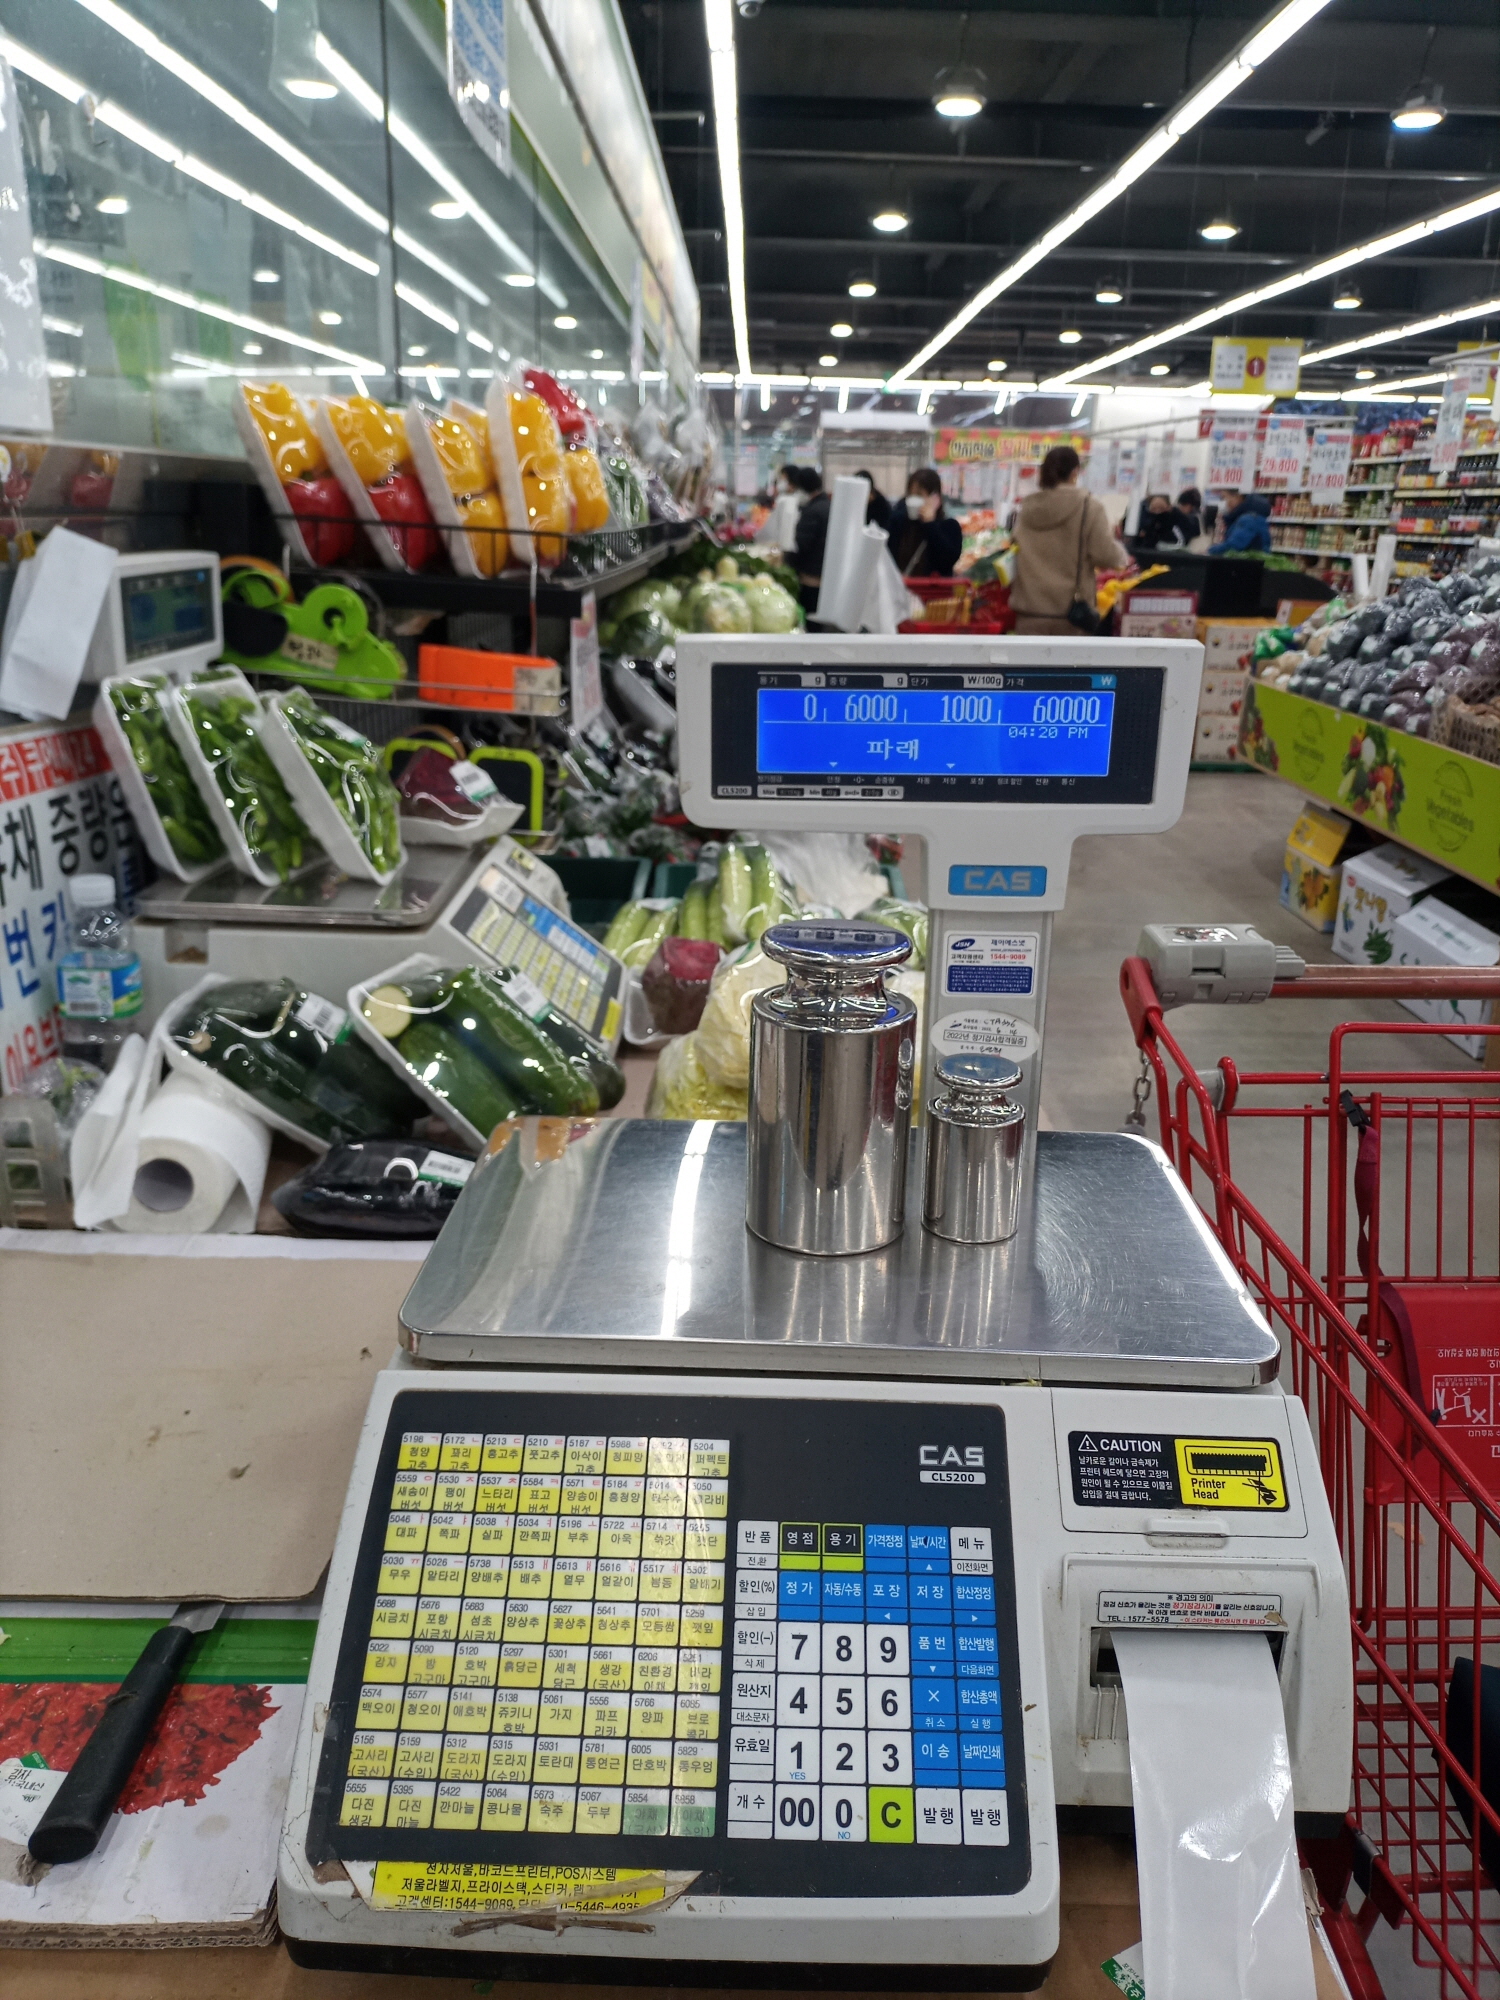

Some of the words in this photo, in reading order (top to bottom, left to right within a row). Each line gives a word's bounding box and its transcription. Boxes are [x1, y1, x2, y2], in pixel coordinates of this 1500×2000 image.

[804, 694, 817, 721] 0
[844, 694, 898, 722] 6000
[940, 695, 992, 722] 1000
[1032, 696, 1100, 724] 60000
[1008, 727, 1058, 738] 04:20
[1068, 727, 1088, 738] PM
[964, 870, 1032, 891] CAS
[403, 1435, 424, 1443] 5198
[445, 1436, 465, 1444] 5172
[486, 1437, 506, 1445] 5213
[1100, 1439, 1162, 1452] CAUTION
[528, 1450, 560, 1460] 풋고추
[919, 1444, 985, 1467] CAS
[1078, 1456, 1106, 1466] 날카로운
[1108, 1456, 1130, 1466] 칼이나
[1131, 1458, 1158, 1468] 금속제가
[932, 1473, 974, 1482] CL5200
[1080, 1467, 1101, 1476] 프린터
[1102, 1468, 1124, 1477] 헤드에
[1125, 1468, 1146, 1478] 닿으면
[1148, 1469, 1170, 1478] 고장의
[1080, 1478, 1102, 1488] 원인이
[1104, 1479, 1112, 1488] 될
[1112, 1480, 1120, 1488] 수
[1122, 1480, 1150, 1489] 있으므로
[1152, 1480, 1173, 1490] 이물질
[1191, 1478, 1226, 1488] Printer
[397, 1486, 428, 1497] 새송이
[482, 1488, 513, 1499] 느타리
[1104, 1490, 1120, 1500] 절대
[1194, 1488, 1219, 1500] Head
[390, 1515, 410, 1523] 5046
[439, 1528, 460, 1539] 쪽파
[519, 1531, 551, 1542] 깐쪽파
[611, 1533, 632, 1544] 아욱
[868, 1535, 903, 1548] 가격정정
[600, 1563, 621, 1571] 5616
[956, 1562, 988, 1572] 이전화면
[389, 1569, 410, 1580] 무우
[427, 1570, 459, 1582] 알타리
[520, 1573, 541, 1584] 배추
[739, 1580, 775, 1593] 할인(%)
[824, 1583, 861, 1596] 자동/수동
[956, 1587, 991, 1600] 합산정정
[376, 1599, 396, 1608] 5688
[426, 1613, 448, 1625] 포항
[553, 1618, 586, 1629] 꽃상추
[791, 1634, 808, 1660] 7
[836, 1636, 852, 1662] 8
[880, 1637, 896, 1663] 9
[958, 1637, 994, 1651] 합산발행
[375, 1656, 397, 1668] 감자
[639, 1666, 672, 1678] 친환경
[962, 1665, 994, 1675] 다음화면
[737, 1684, 771, 1698] 원산지
[961, 1690, 997, 1704] 합산총액
[790, 1687, 808, 1714] 4
[836, 1688, 853, 1715] 5
[881, 1689, 898, 1716] 6
[453, 1705, 487, 1717] 애호박
[737, 1712, 769, 1722] 대소문자
[642, 1712, 664, 1724] 양파
[734, 1738, 769, 1752] 유효일
[353, 1749, 387, 1761] 고사리
[791, 1742, 802, 1769] 1
[836, 1743, 853, 1771] 2
[882, 1744, 899, 1772] 3
[964, 1745, 1001, 1759] 날짜인쇄
[790, 1772, 806, 1780] YES
[346, 1783, 366, 1792] 5655
[487, 1802, 522, 1815] 콩나물
[587, 1807, 610, 1819] 두부
[780, 1797, 814, 1826] 00
[836, 1799, 852, 1828] 0
[881, 1802, 901, 1828] C
